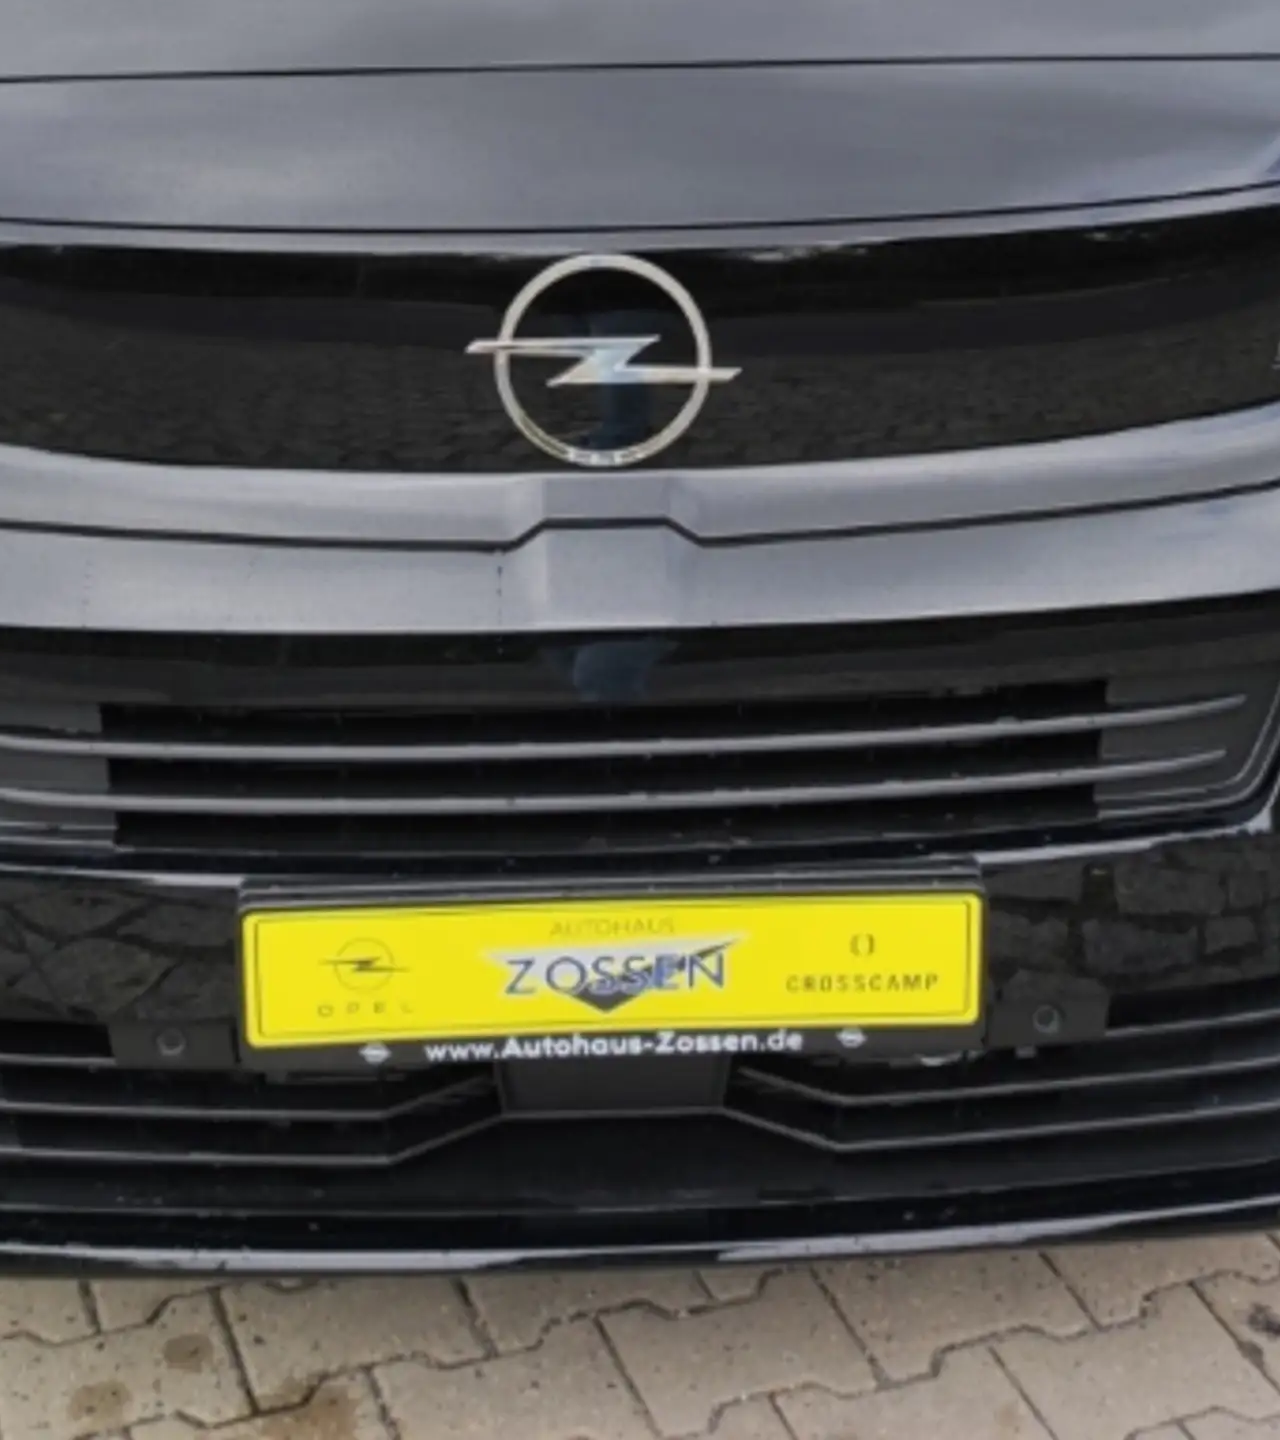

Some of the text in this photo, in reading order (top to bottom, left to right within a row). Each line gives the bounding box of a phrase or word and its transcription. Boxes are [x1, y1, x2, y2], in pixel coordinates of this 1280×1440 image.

[549, 917, 675, 938] AUTOHAUS
[505, 951, 725, 996] ZOSSEN
[785, 972, 940, 994] CROSSCAMP
[317, 1000, 415, 1018] OPEL
[424, 1028, 805, 1061] www.Autohaus-Zossen.de
